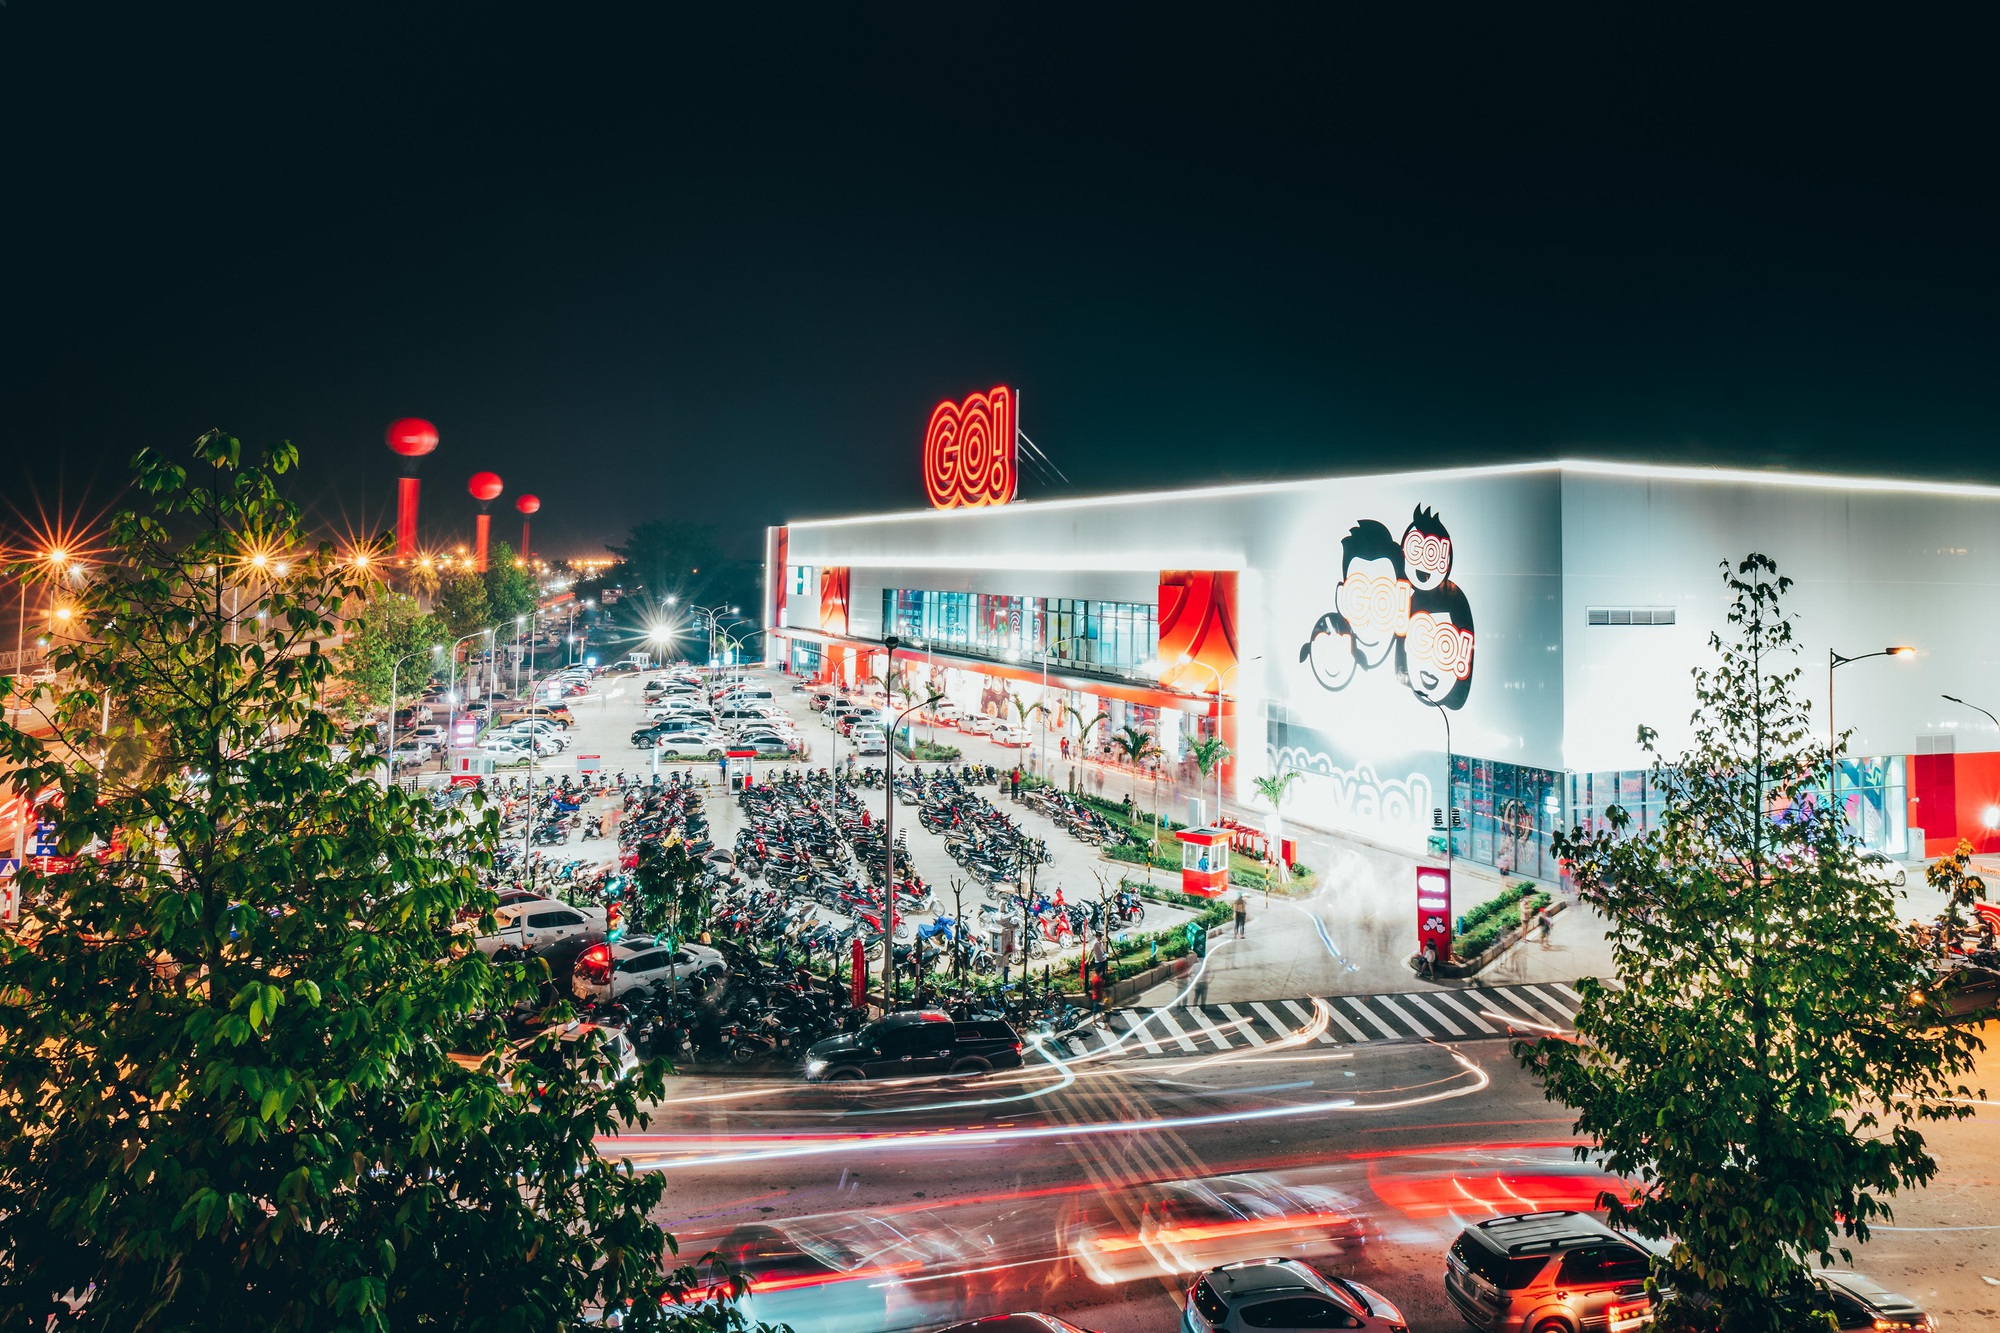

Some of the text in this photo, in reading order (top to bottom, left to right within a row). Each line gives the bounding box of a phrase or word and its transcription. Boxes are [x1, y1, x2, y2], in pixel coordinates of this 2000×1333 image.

[925, 385, 1011, 510] GO!
[1403, 530, 1450, 574] GO!
[1340, 572, 1413, 636] GO!
[1405, 611, 1475, 681] GO!
